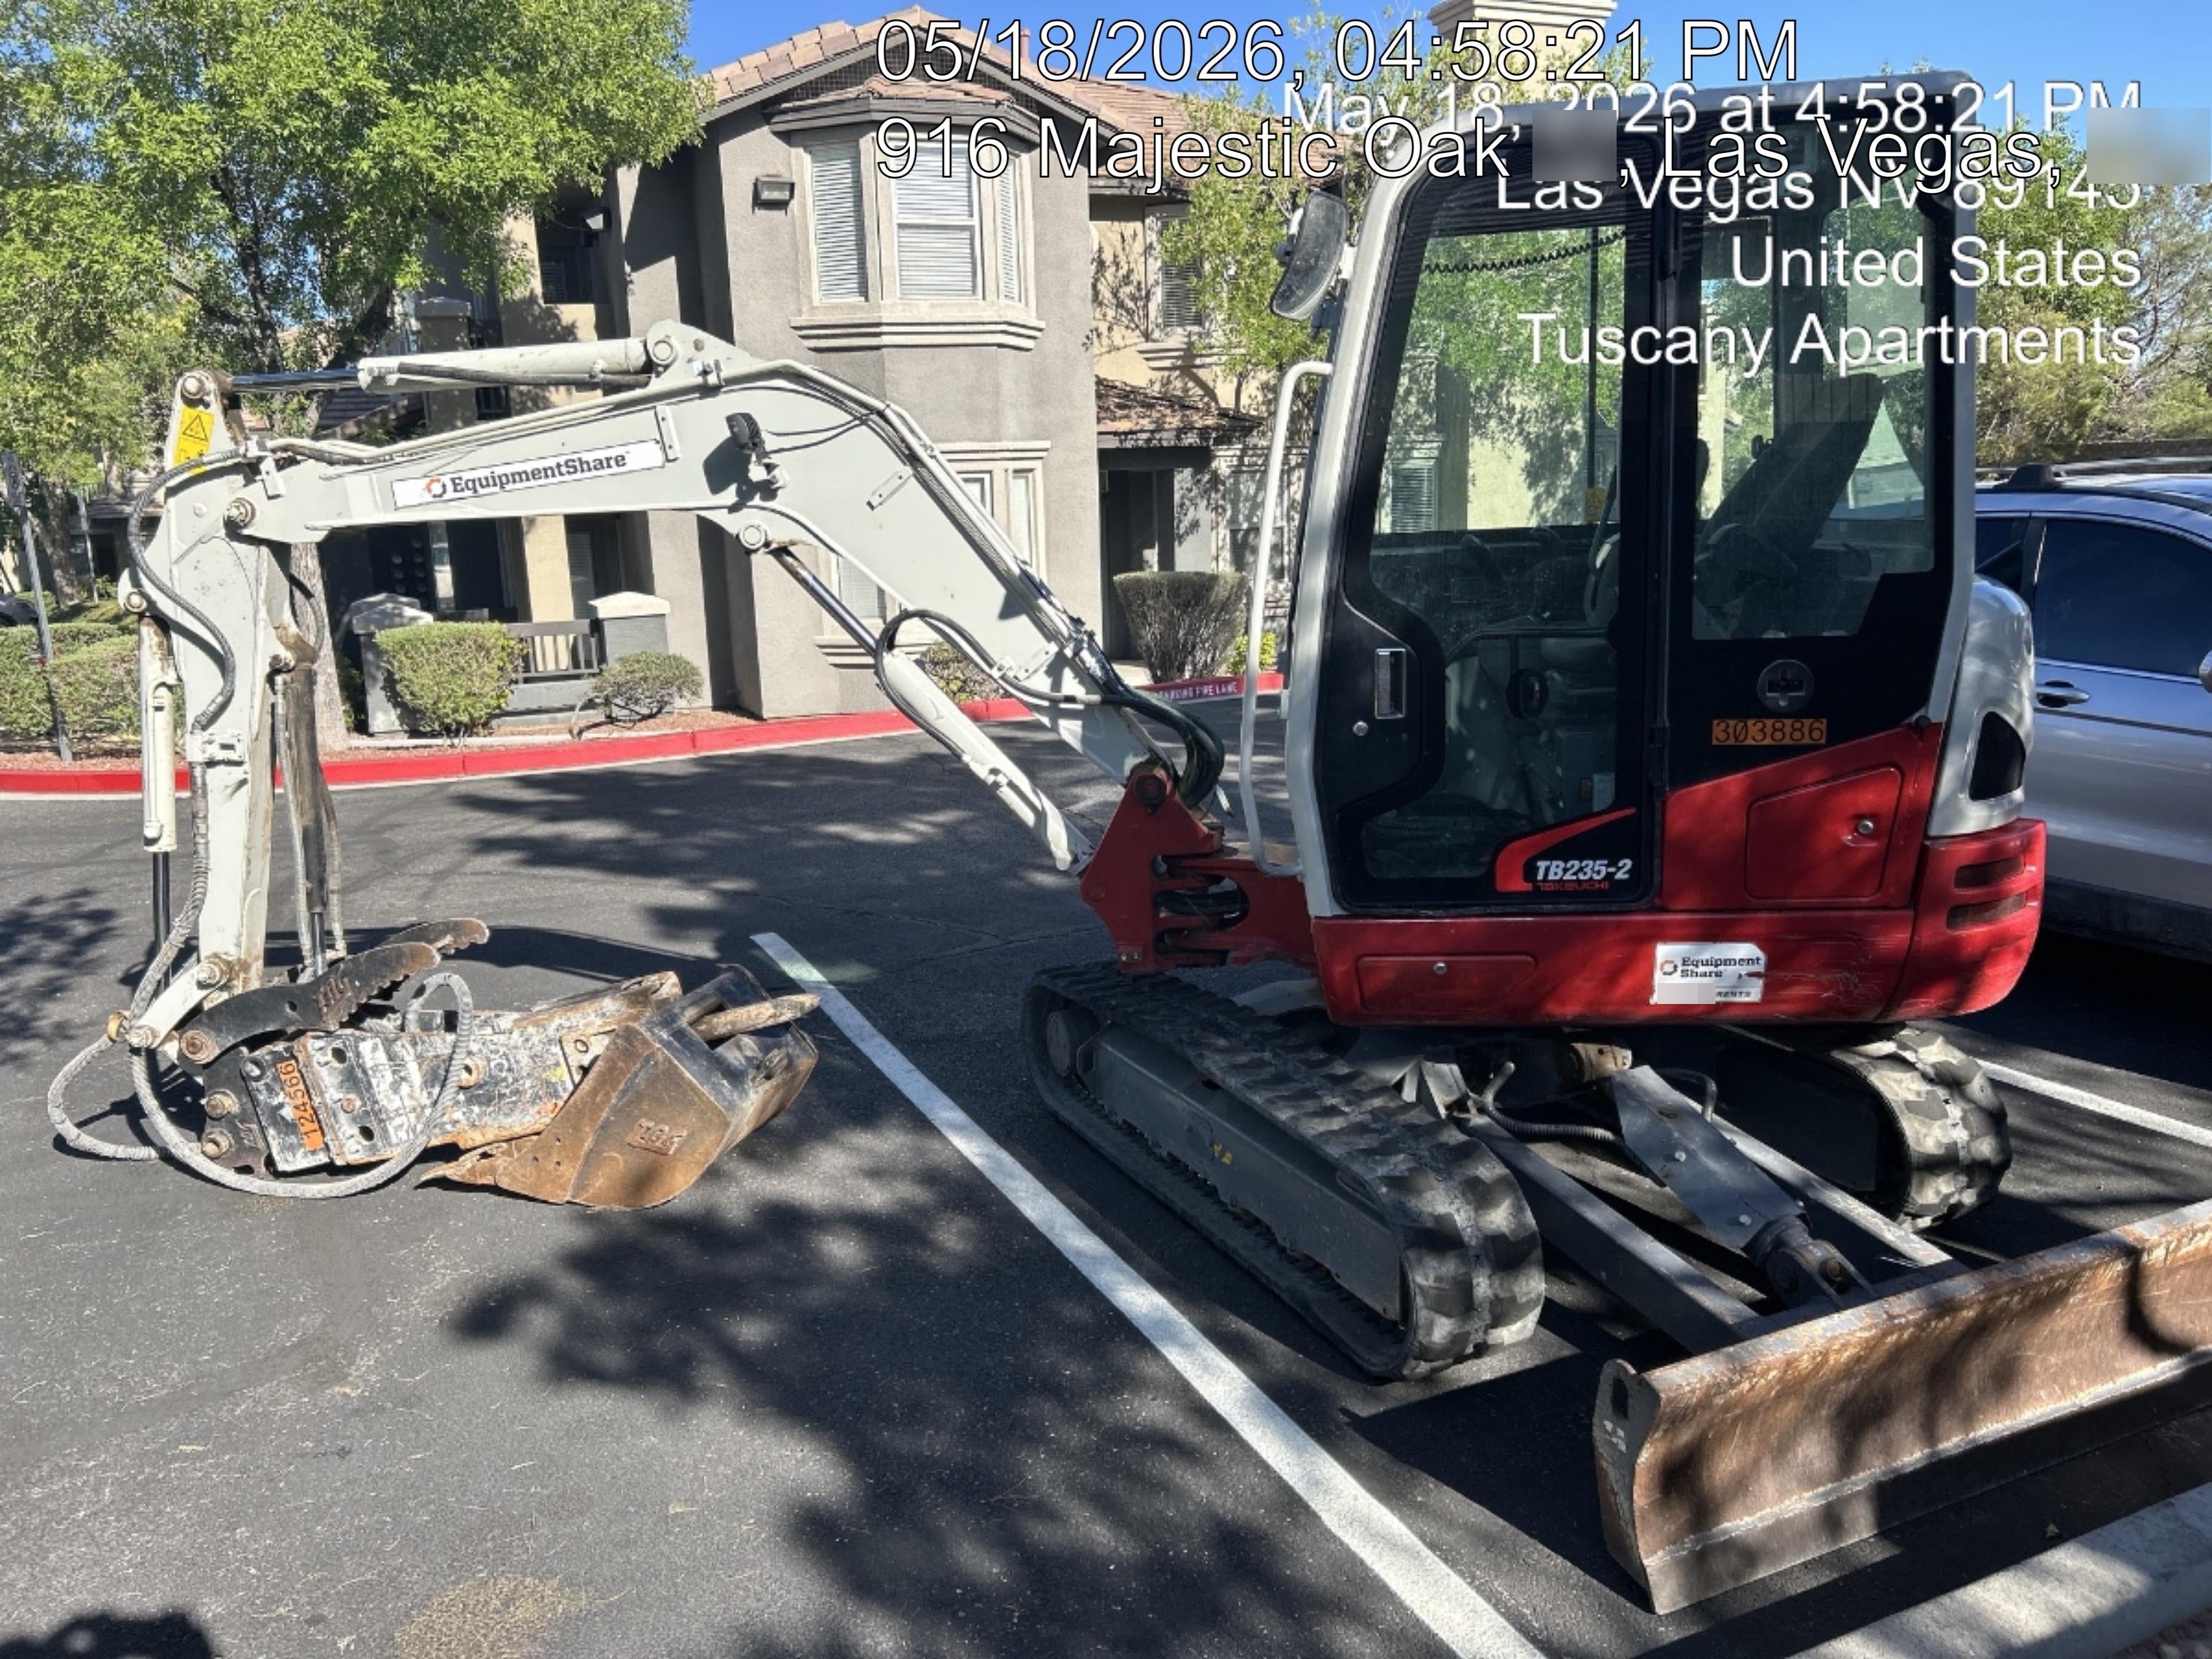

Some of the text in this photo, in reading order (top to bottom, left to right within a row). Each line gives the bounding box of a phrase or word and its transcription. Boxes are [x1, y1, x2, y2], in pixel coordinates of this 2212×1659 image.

[450, 452, 627, 494] EquipmentShare
[1216, 681, 1237, 694] LANE
[1716, 721, 1824, 742] 303886
[1537, 858, 1632, 880] TB235-2
[1681, 956, 1762, 968] Equipment
[1681, 969, 1722, 978] Share
